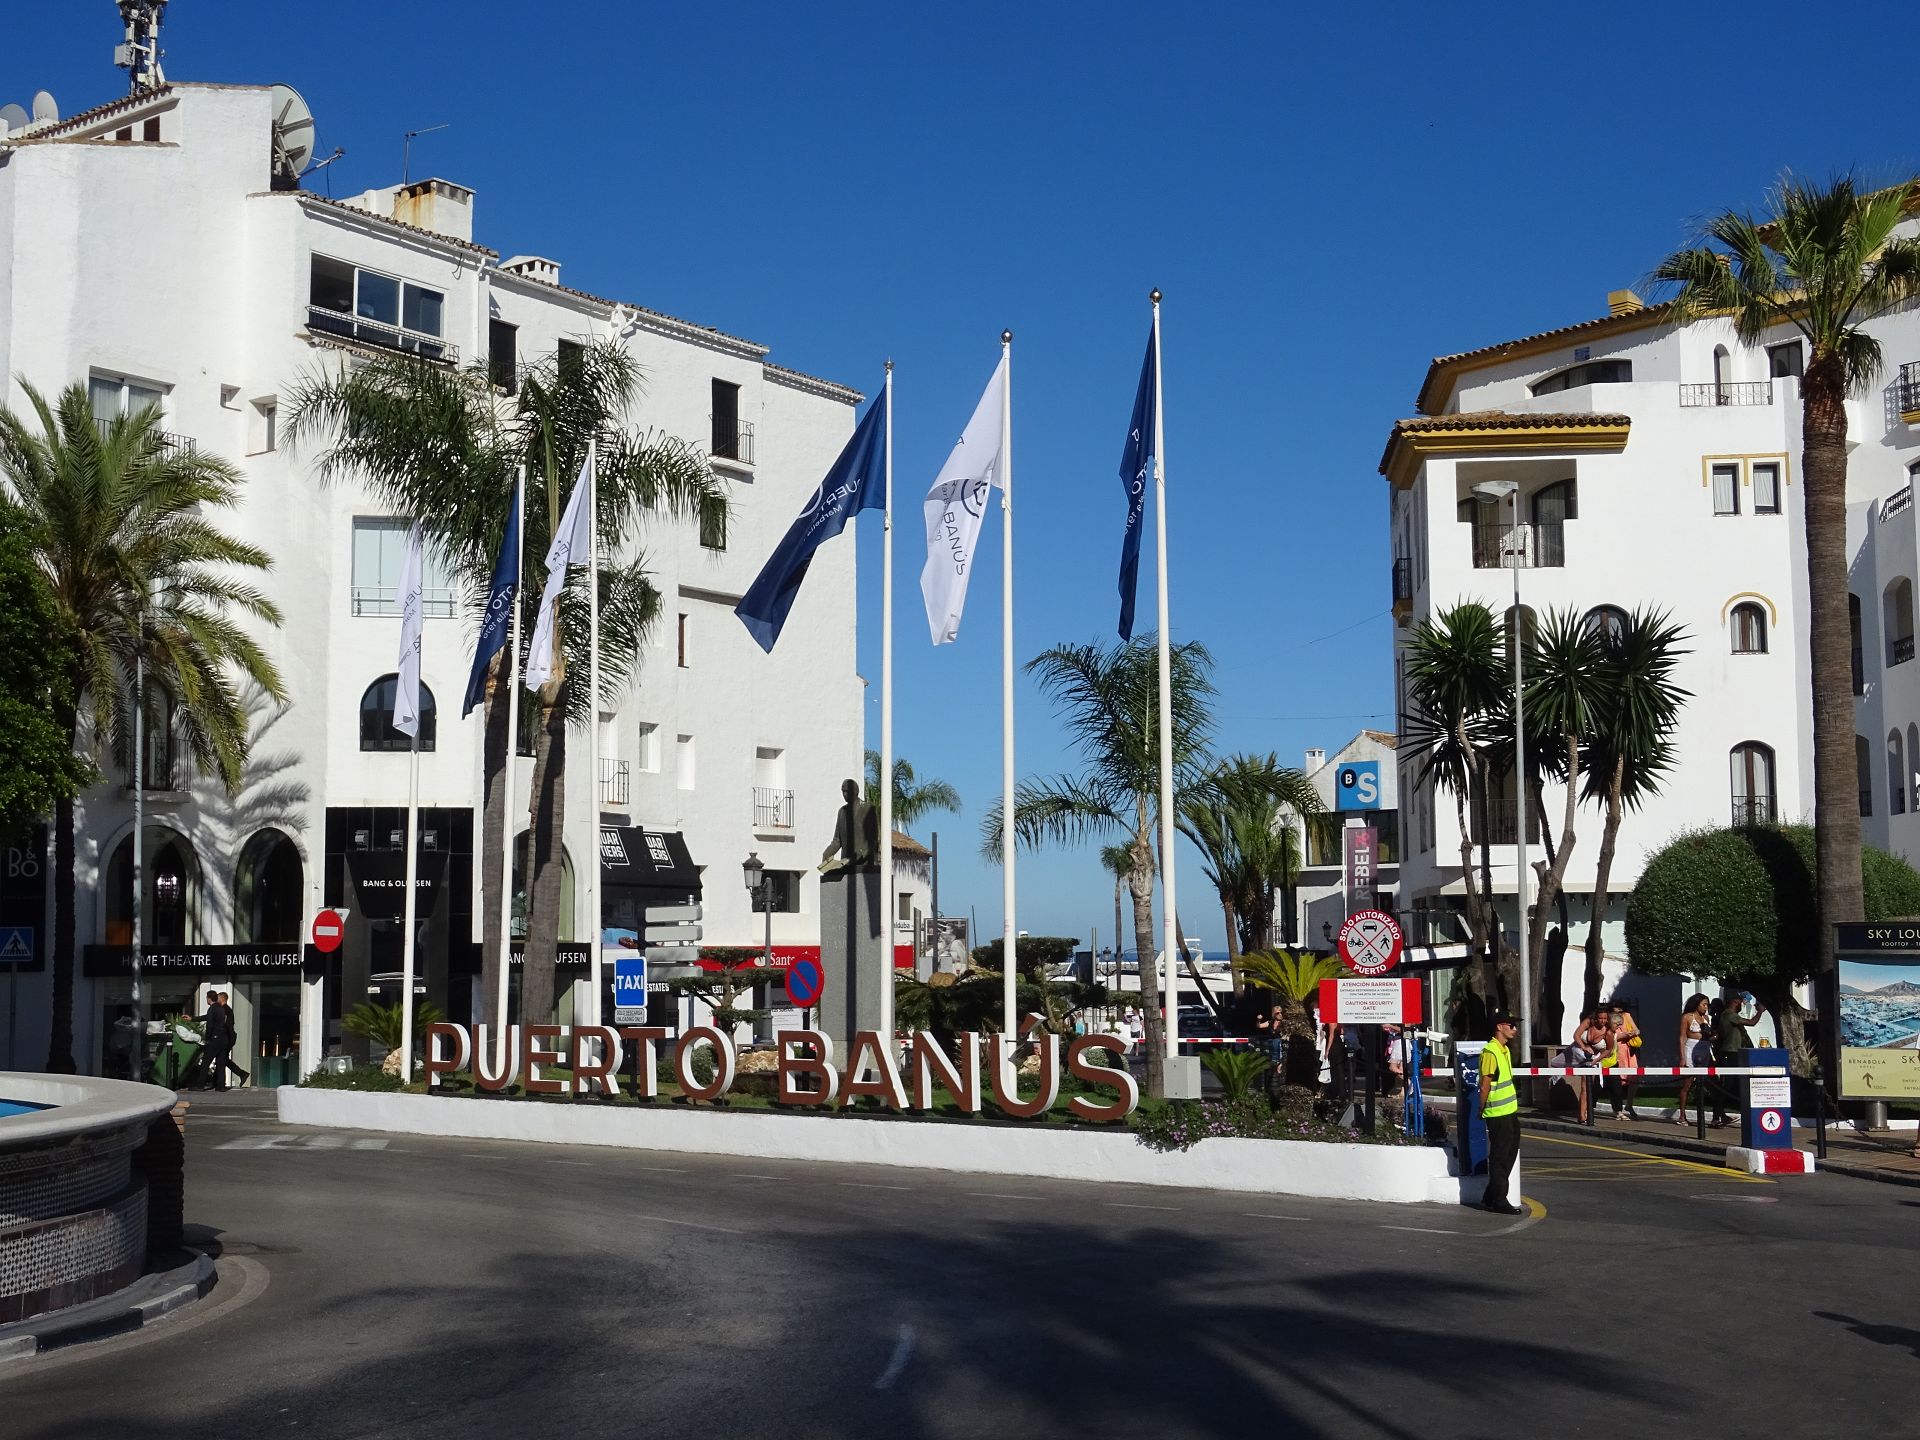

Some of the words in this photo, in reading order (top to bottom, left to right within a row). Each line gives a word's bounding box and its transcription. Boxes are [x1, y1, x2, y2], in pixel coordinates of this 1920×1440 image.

[1340, 919, 1355, 941] SOLO
[1355, 911, 1400, 940] AUTORIZADO
[1867, 929, 1892, 939] SKY
[161, 954, 212, 967] THEATRE
[226, 953, 252, 966] BANG
[254, 953, 261, 966] &
[1353, 964, 1387, 975] PUERTO
[616, 974, 644, 990] TAXI
[425, 1022, 736, 1100] PUERTO
[777, 1012, 1139, 1121] BANÚS
